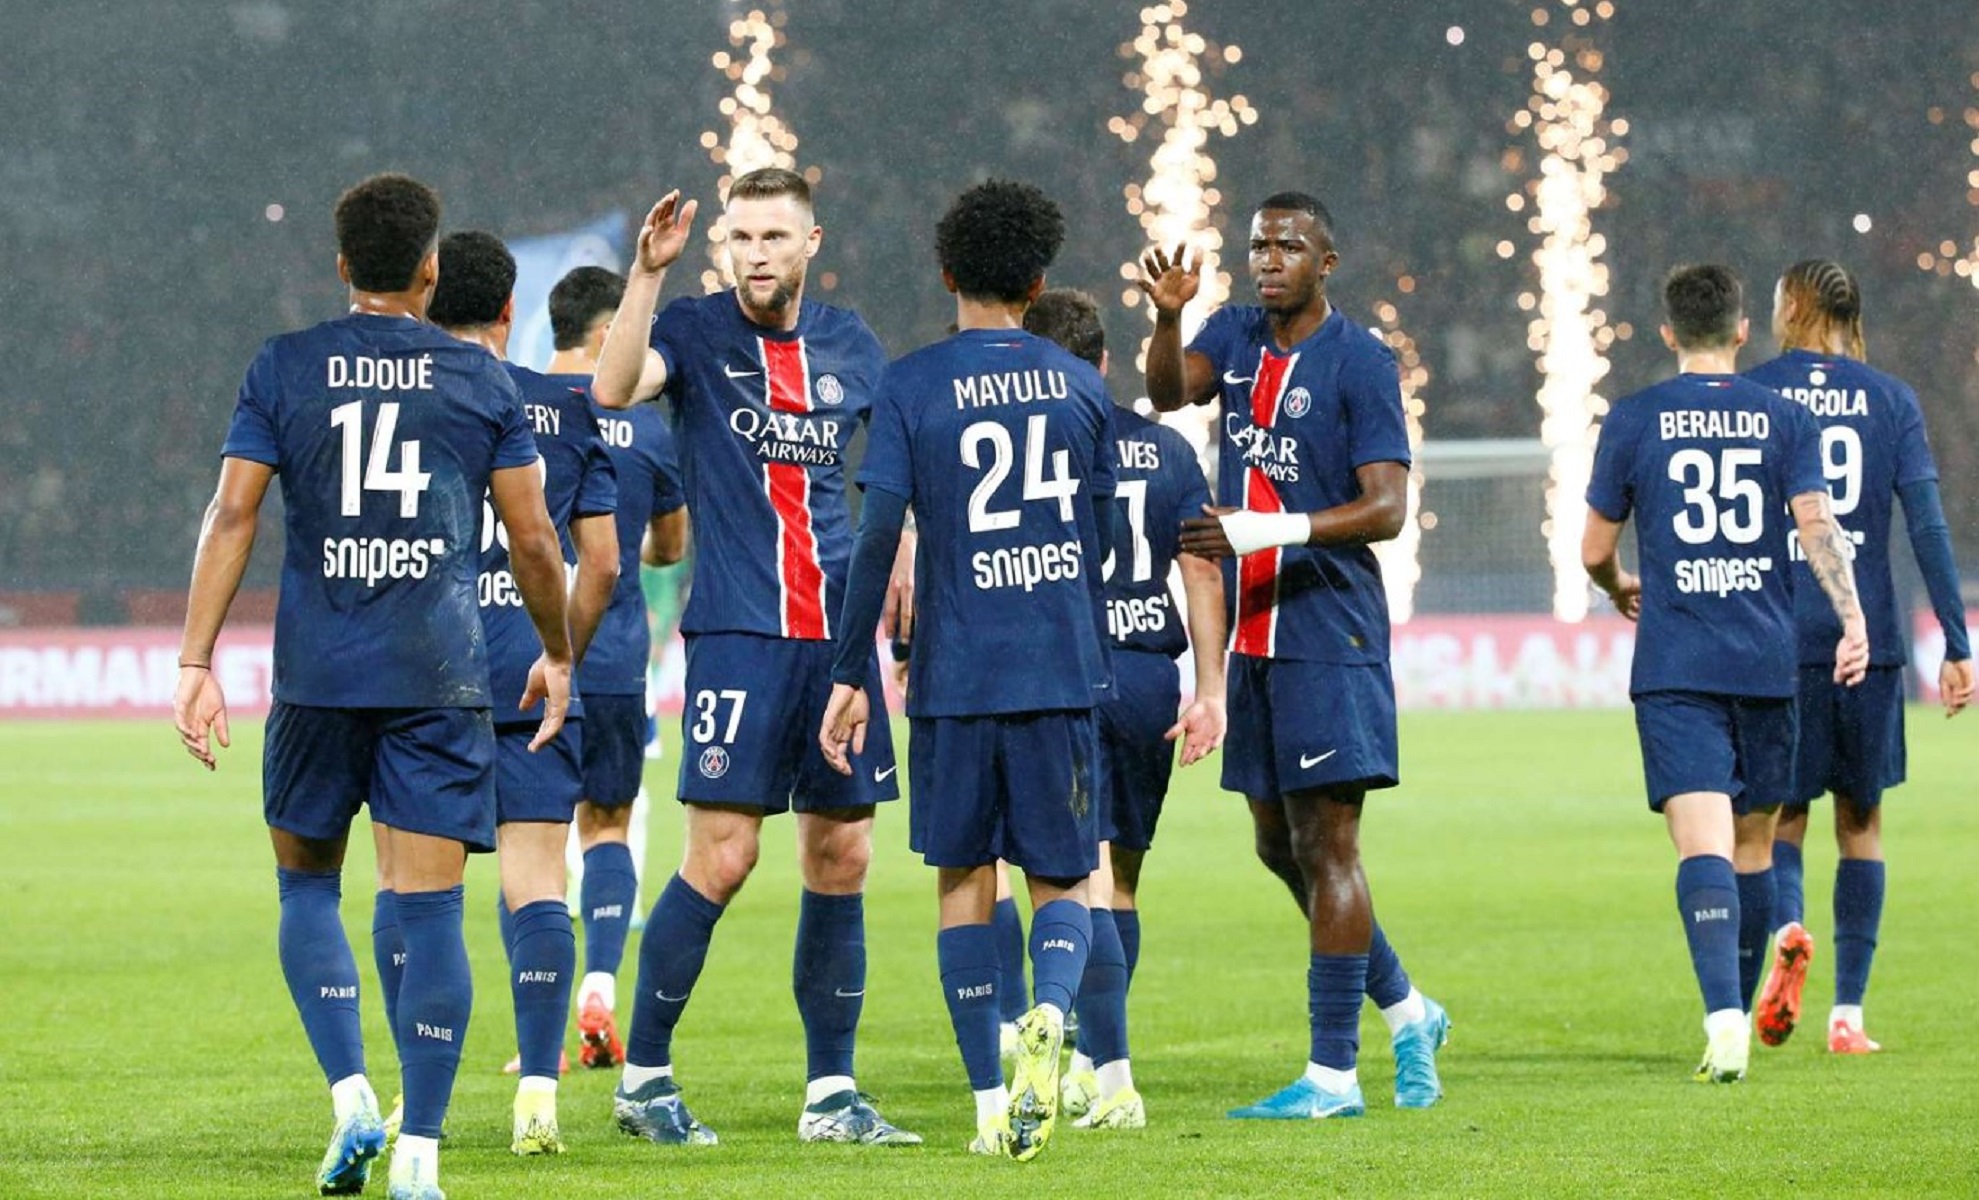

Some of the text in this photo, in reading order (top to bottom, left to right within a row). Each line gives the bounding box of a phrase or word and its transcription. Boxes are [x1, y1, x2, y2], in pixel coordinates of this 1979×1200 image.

[327, 353, 434, 390] D.DOUÉ
[953, 369, 1068, 410] MAYULU
[730, 407, 839, 449] QATAR
[1660, 410, 1770, 441] BERALDO
[331, 400, 432, 519] 14
[757, 441, 837, 466] AIRWAYS
[960, 414, 1081, 533] 24
[1114, 440, 1160, 469] VES
[1668, 448, 1764, 545] 35
[323, 537, 432, 588] snipes
[972, 541, 1081, 592] snipes
[1674, 557, 1765, 598] snipes
[692, 689, 747, 744] 37
[320, 985, 357, 999] PARIS
[518, 970, 557, 984] PARIS
[957, 982, 993, 1000] PARIS
[416, 1021, 453, 1042] PARIS
